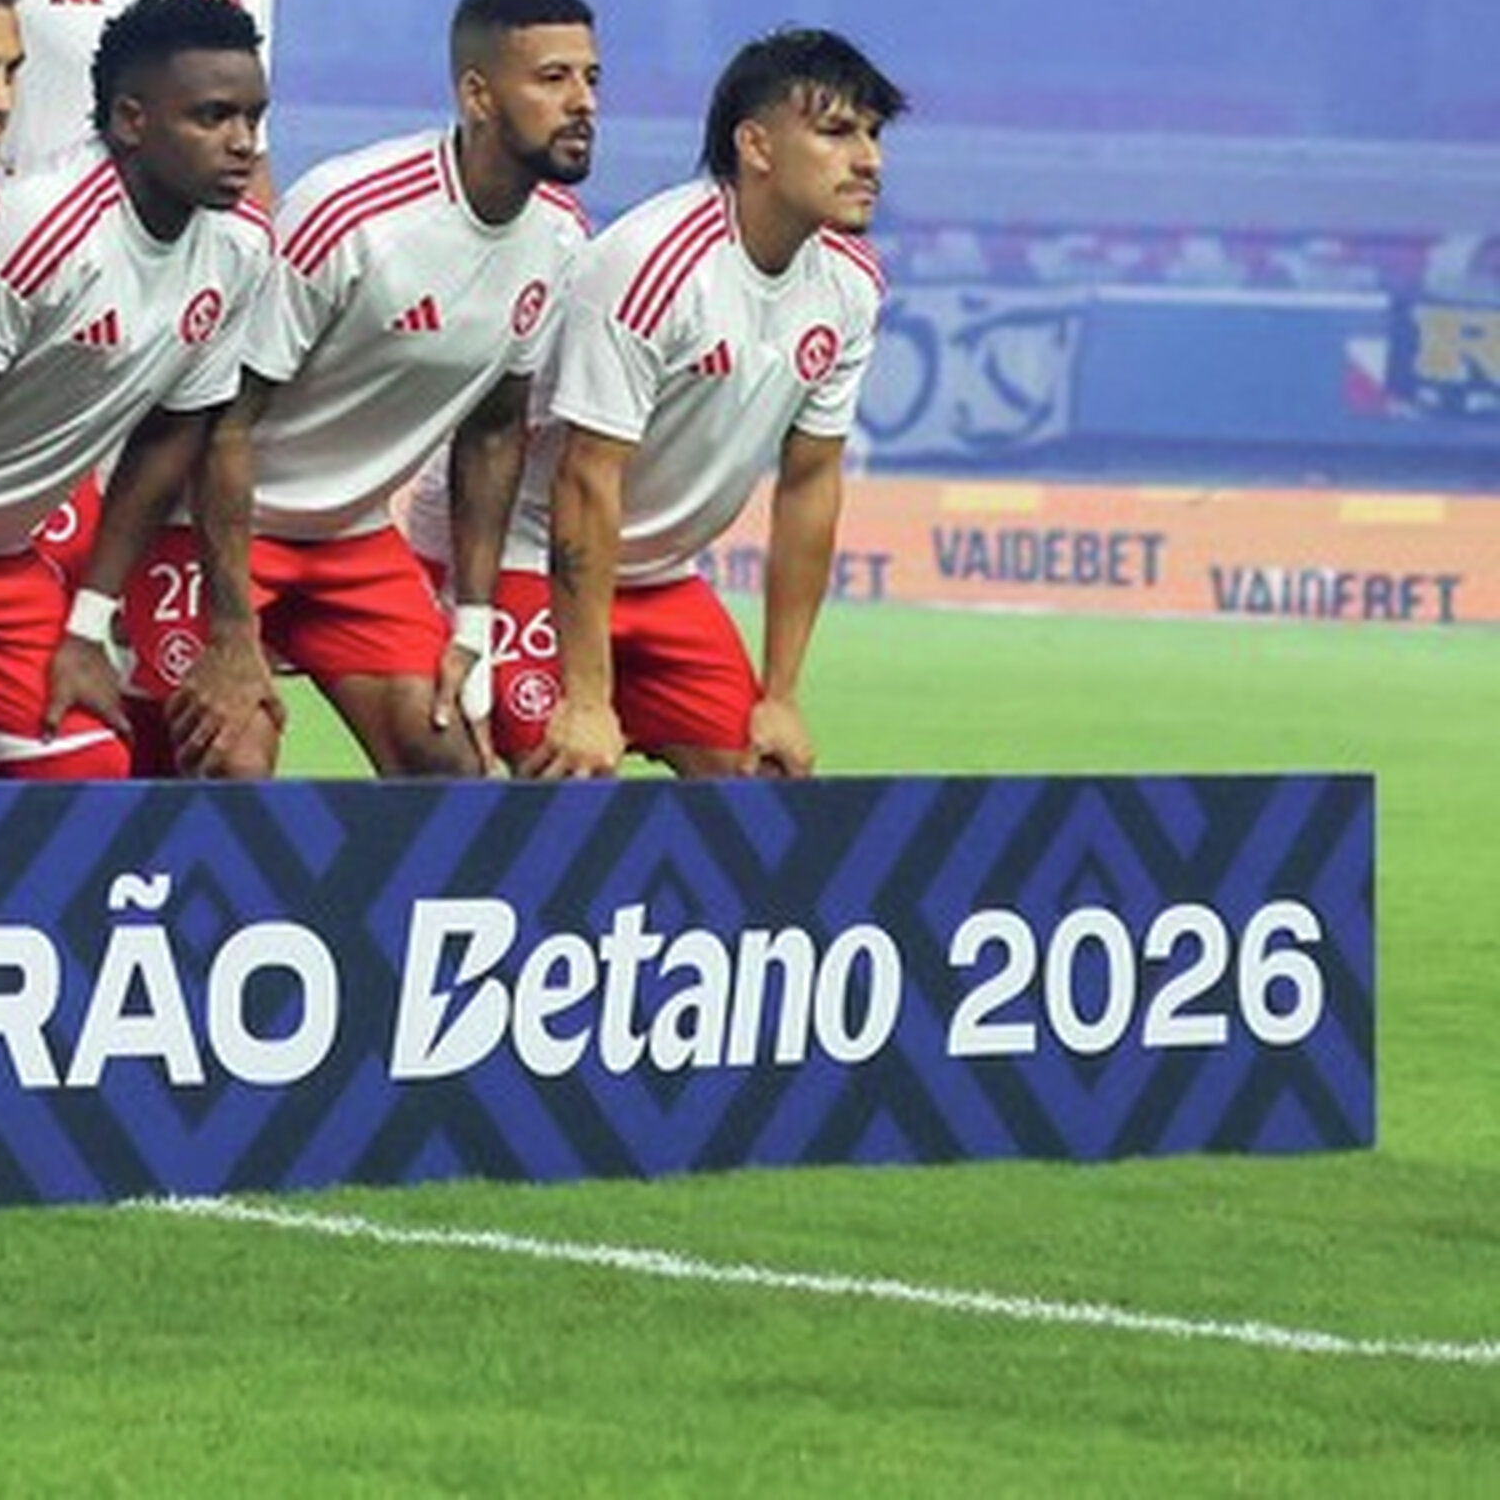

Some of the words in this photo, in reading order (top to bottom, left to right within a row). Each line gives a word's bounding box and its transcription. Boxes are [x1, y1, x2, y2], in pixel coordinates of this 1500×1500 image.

[932, 525, 1167, 586] VAIDEBET
[490, 608, 558, 664] 26
[390, 899, 901, 1081] Betano
[946, 902, 1324, 1055] 2026
